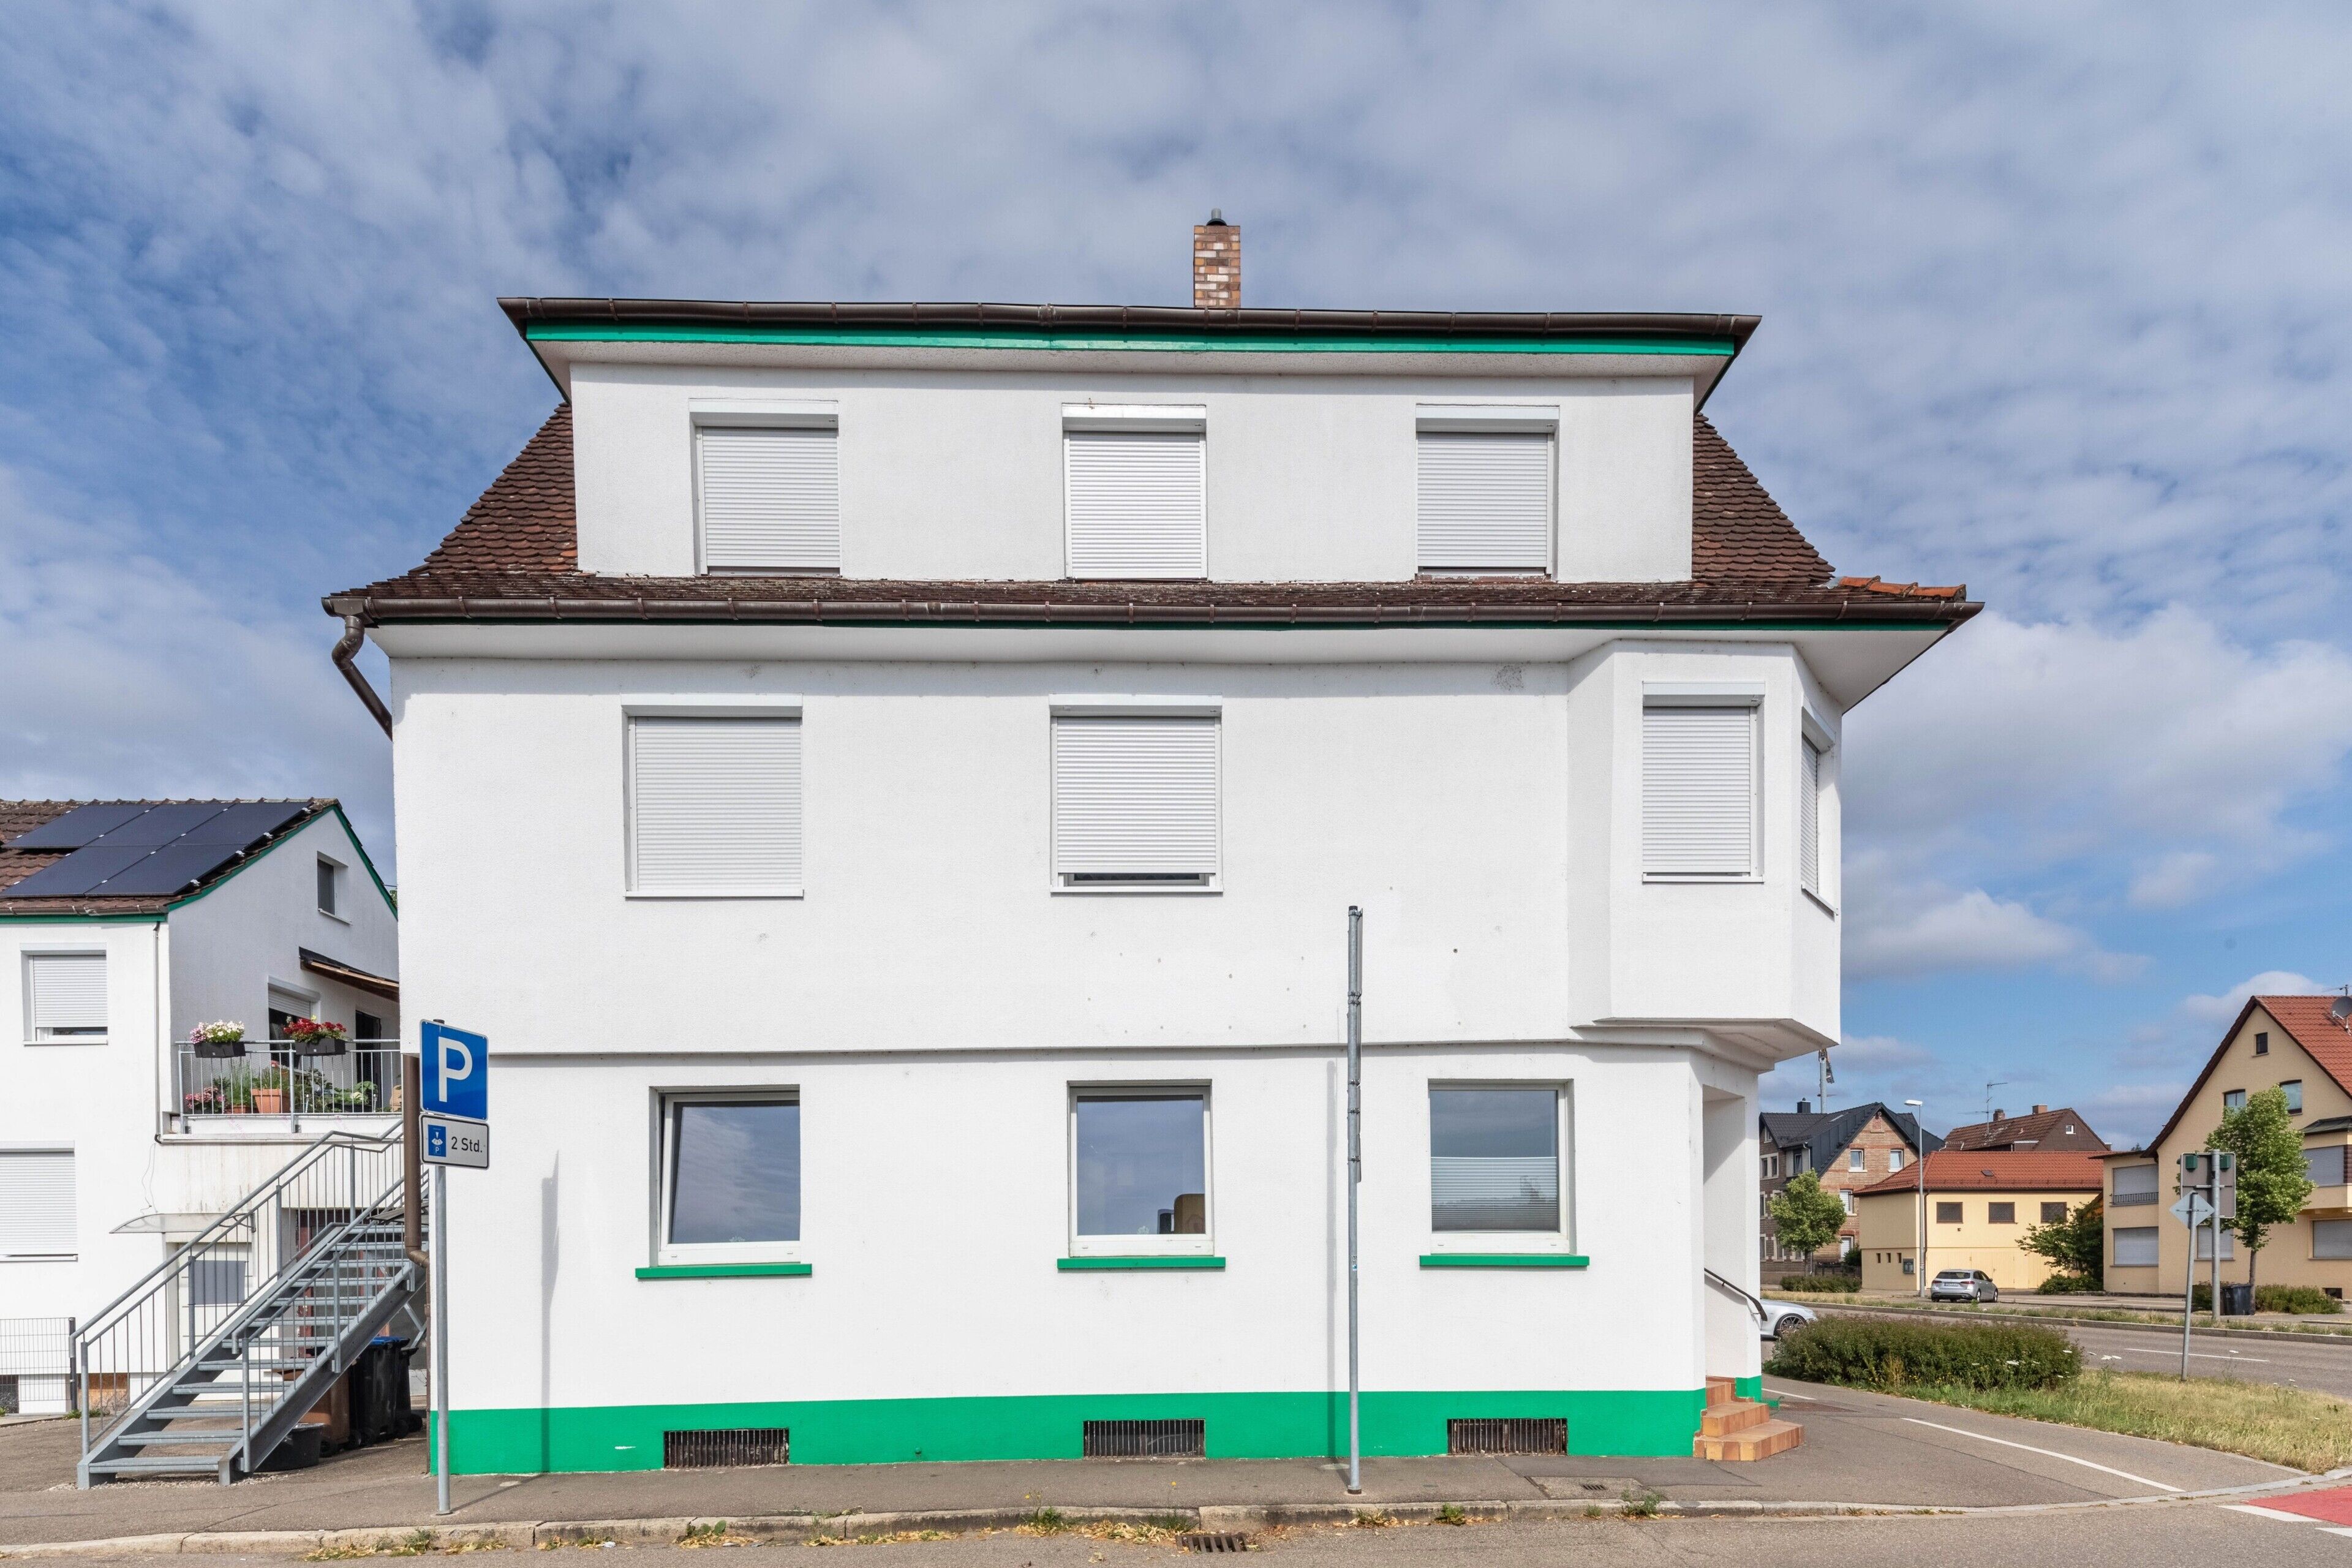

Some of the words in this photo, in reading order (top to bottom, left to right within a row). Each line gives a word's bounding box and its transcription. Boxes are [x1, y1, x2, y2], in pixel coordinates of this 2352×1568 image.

[438, 1036, 473, 1102] P
[451, 1136, 458, 1150] 2
[461, 1137, 483, 1153] Std.
